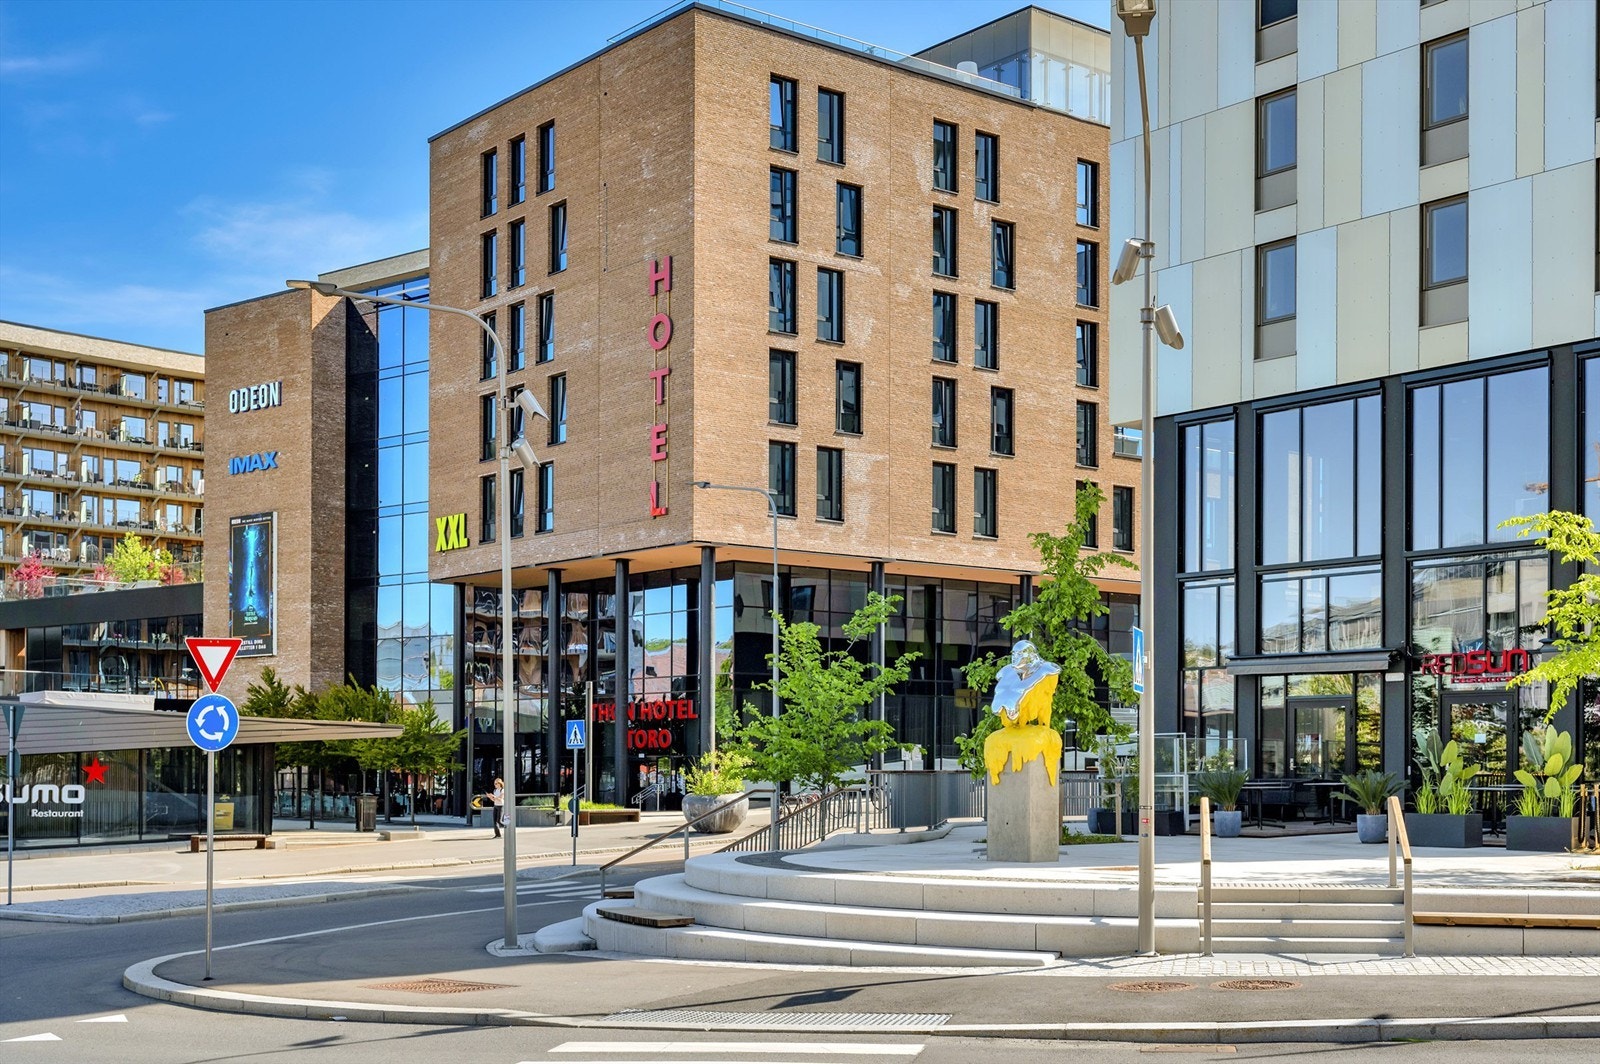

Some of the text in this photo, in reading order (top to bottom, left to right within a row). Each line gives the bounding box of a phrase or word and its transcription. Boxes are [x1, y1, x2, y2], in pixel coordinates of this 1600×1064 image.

[229, 381, 282, 414] ODEON
[648, 255, 673, 517] HOTEL
[229, 451, 278, 475] IMAX
[435, 513, 469, 552] XXL
[640, 699, 698, 721] HOTEL
[627, 728, 672, 750] TORO
[31, 808, 84, 818] Restaurant
